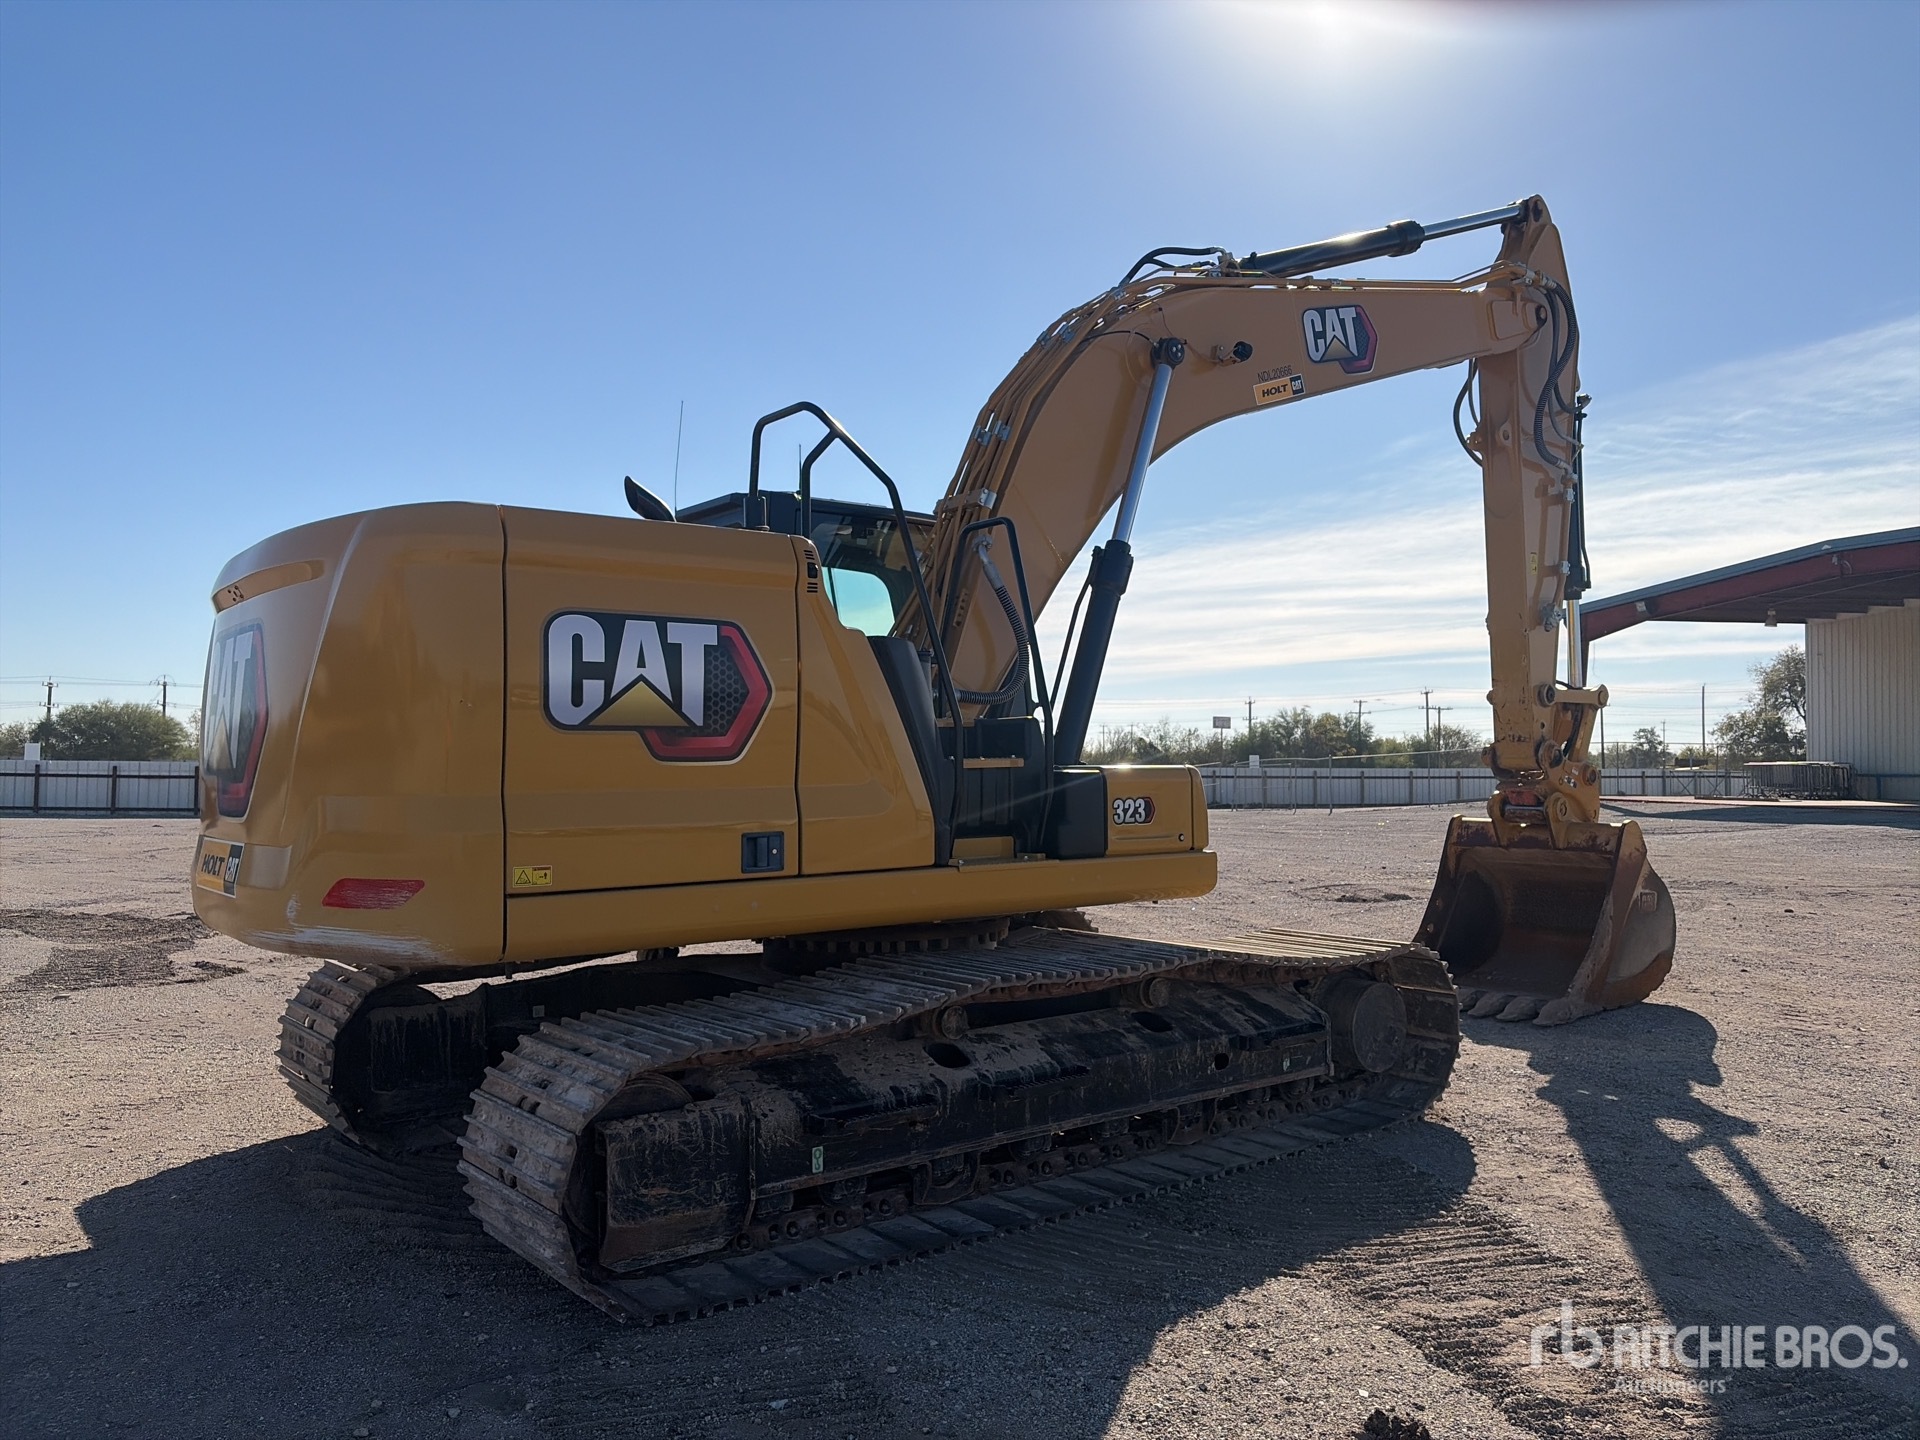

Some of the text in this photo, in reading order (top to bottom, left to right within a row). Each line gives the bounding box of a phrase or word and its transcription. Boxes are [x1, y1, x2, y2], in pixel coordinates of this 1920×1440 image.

[1303, 307, 1358, 361] CAT
[1262, 379, 1302, 397] HOLT CAT
[548, 614, 718, 727] CAT
[205, 631, 254, 769] CAT
[1113, 798, 1146, 824] 323
[201, 853, 240, 883] HOLT CAT
